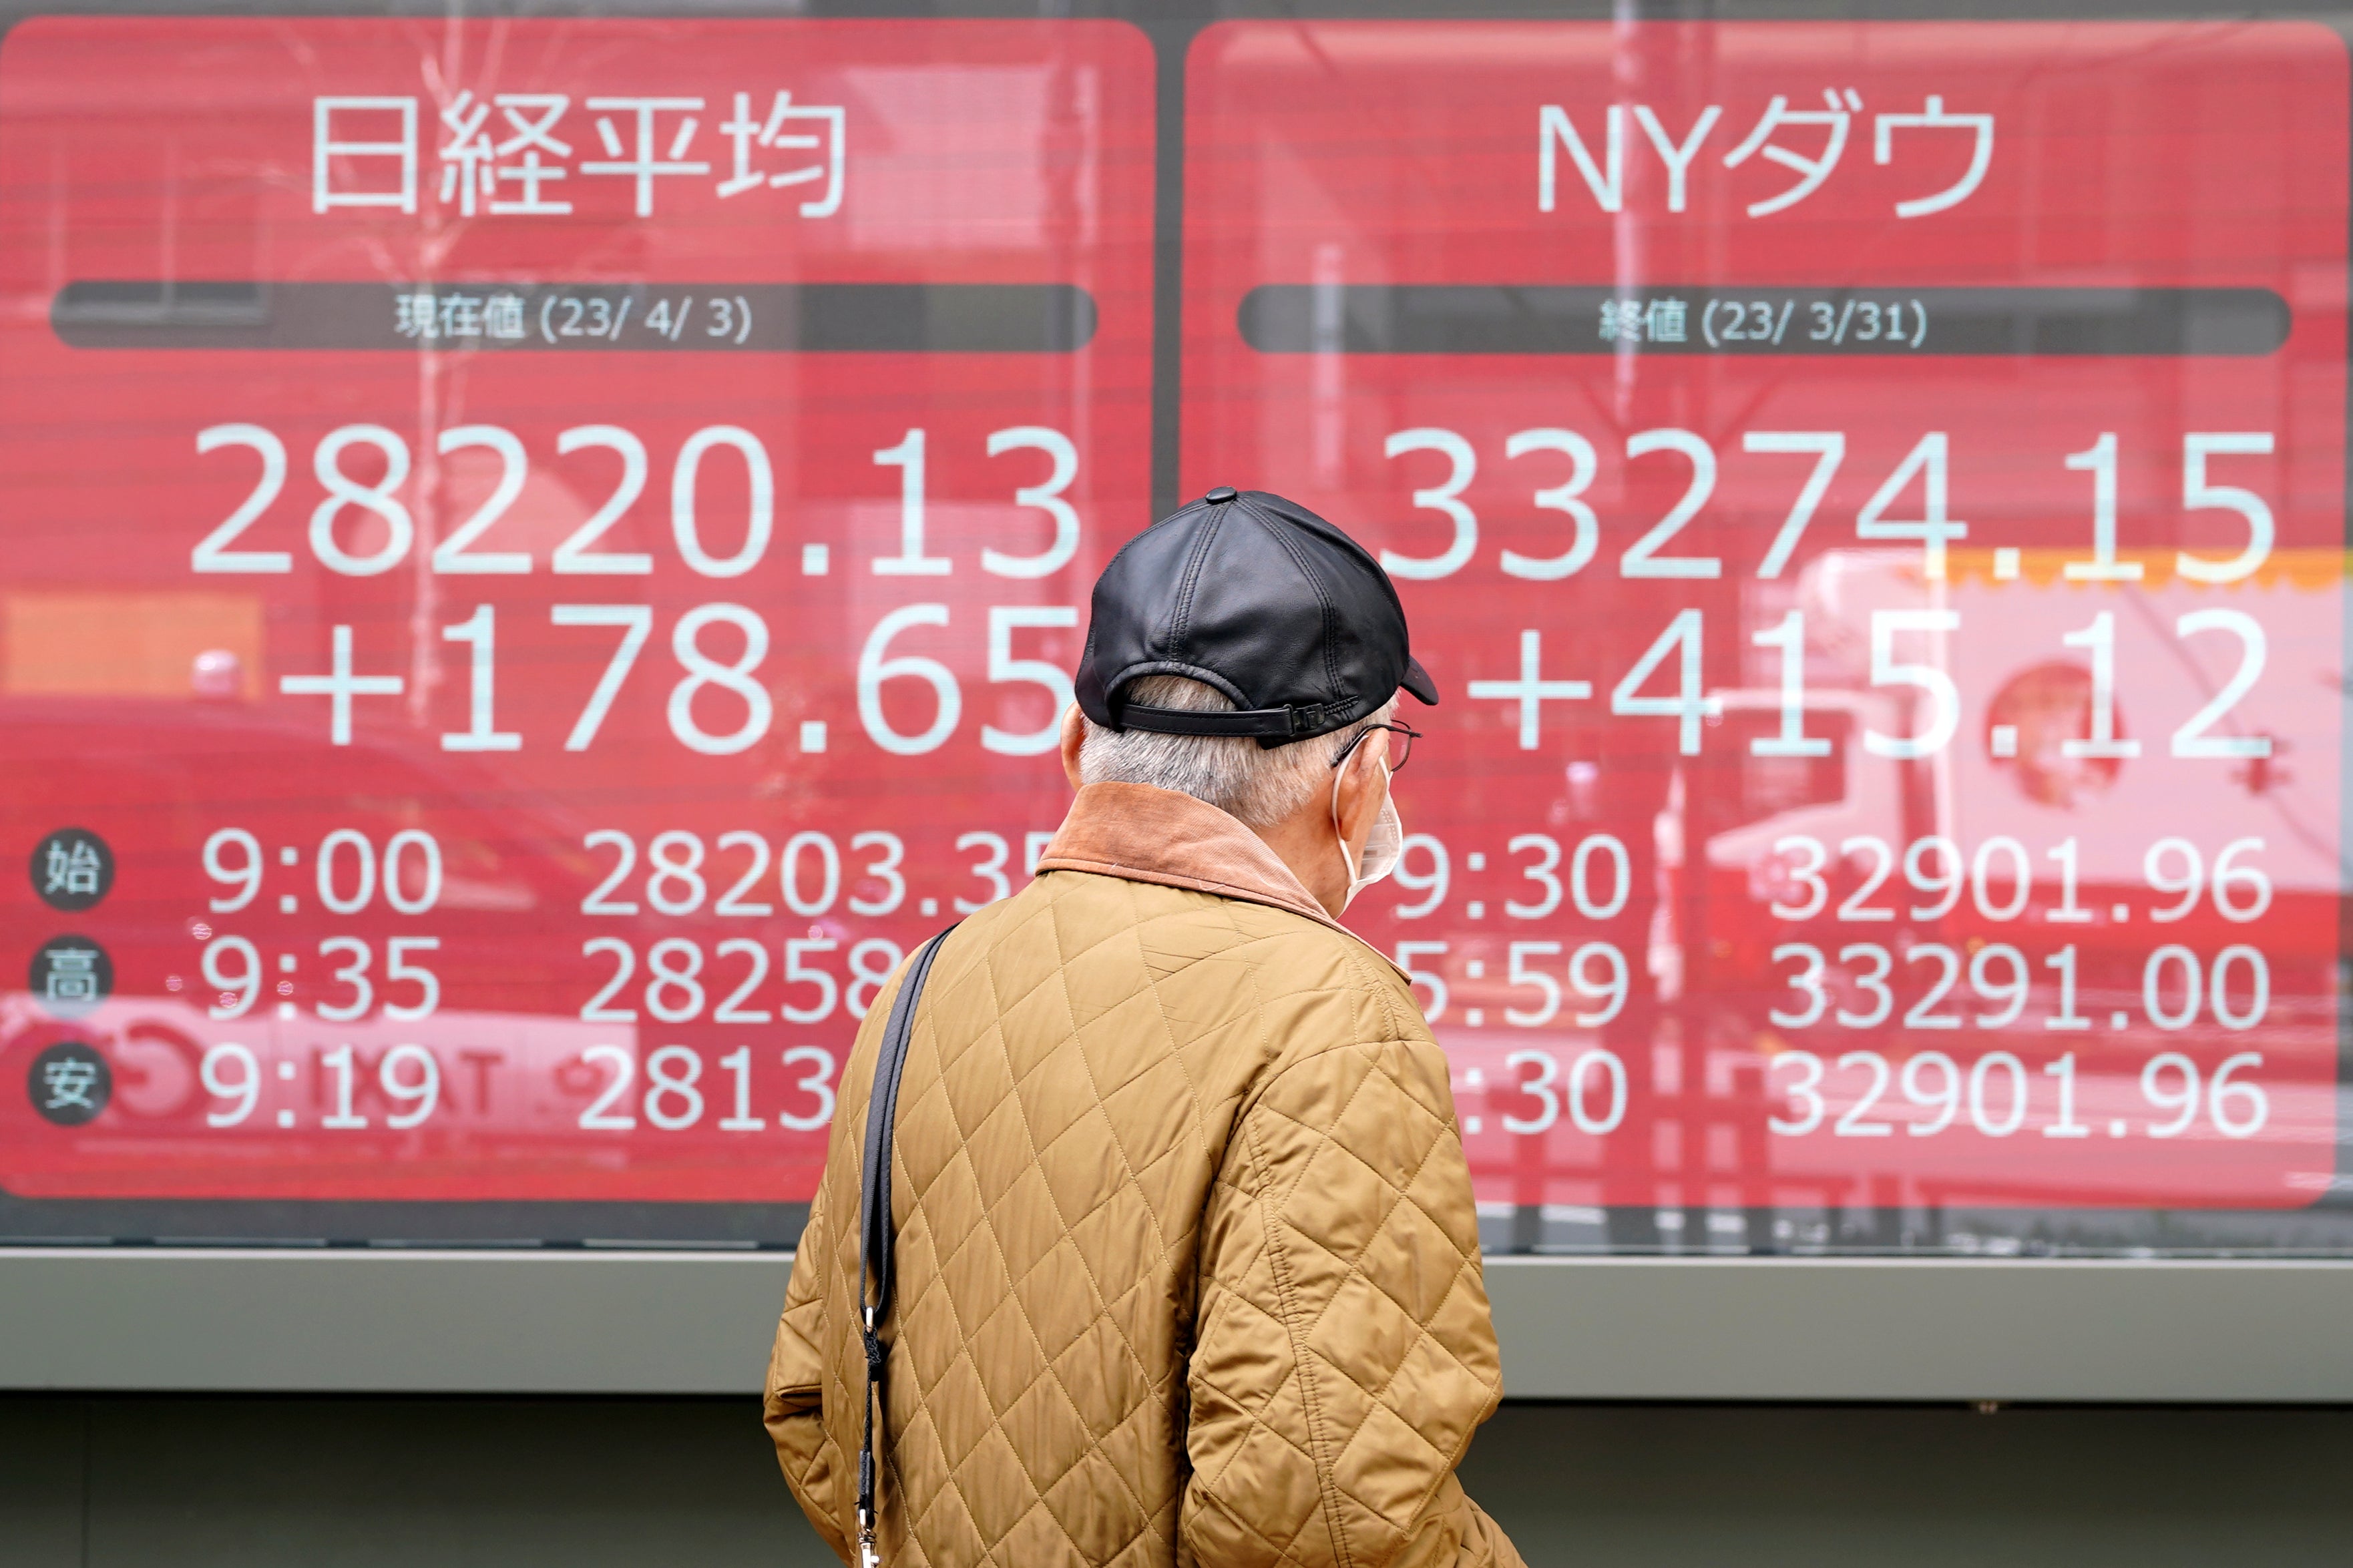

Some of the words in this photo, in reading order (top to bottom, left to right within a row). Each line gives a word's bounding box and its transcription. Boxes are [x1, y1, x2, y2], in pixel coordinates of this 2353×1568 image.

[312, 89, 845, 218] 日経平均
[1538, 87, 1994, 218] NYダウ
[394, 293, 526, 339] 現在値
[540, 295, 633, 344] (23/
[644, 295, 692, 342] 4/
[706, 295, 752, 344] 3)
[1598, 297, 1688, 342] 終値
[1702, 299, 1794, 347] (23/
[1809, 299, 1928, 347] 3/31)
[191, 423, 1080, 579] 28220.13
[1379, 427, 2275, 582] 33274.15
[279, 602, 1078, 757] +178.65
[1468, 607, 2272, 758] +415.12
[44, 838, 101, 894] 始
[202, 827, 442, 914] 9:00
[1392, 834, 1630, 920] 9:30
[1770, 834, 2273, 923] 32901.96
[45, 947, 98, 1003] 高
[202, 935, 440, 1021] 9:35
[1394, 941, 1630, 1027] 5:59
[1769, 943, 2270, 1031] 33291.00
[43, 1057, 97, 1110] 安
[200, 1042, 439, 1129] 9:19
[1767, 1051, 2270, 1139] 32901.96
